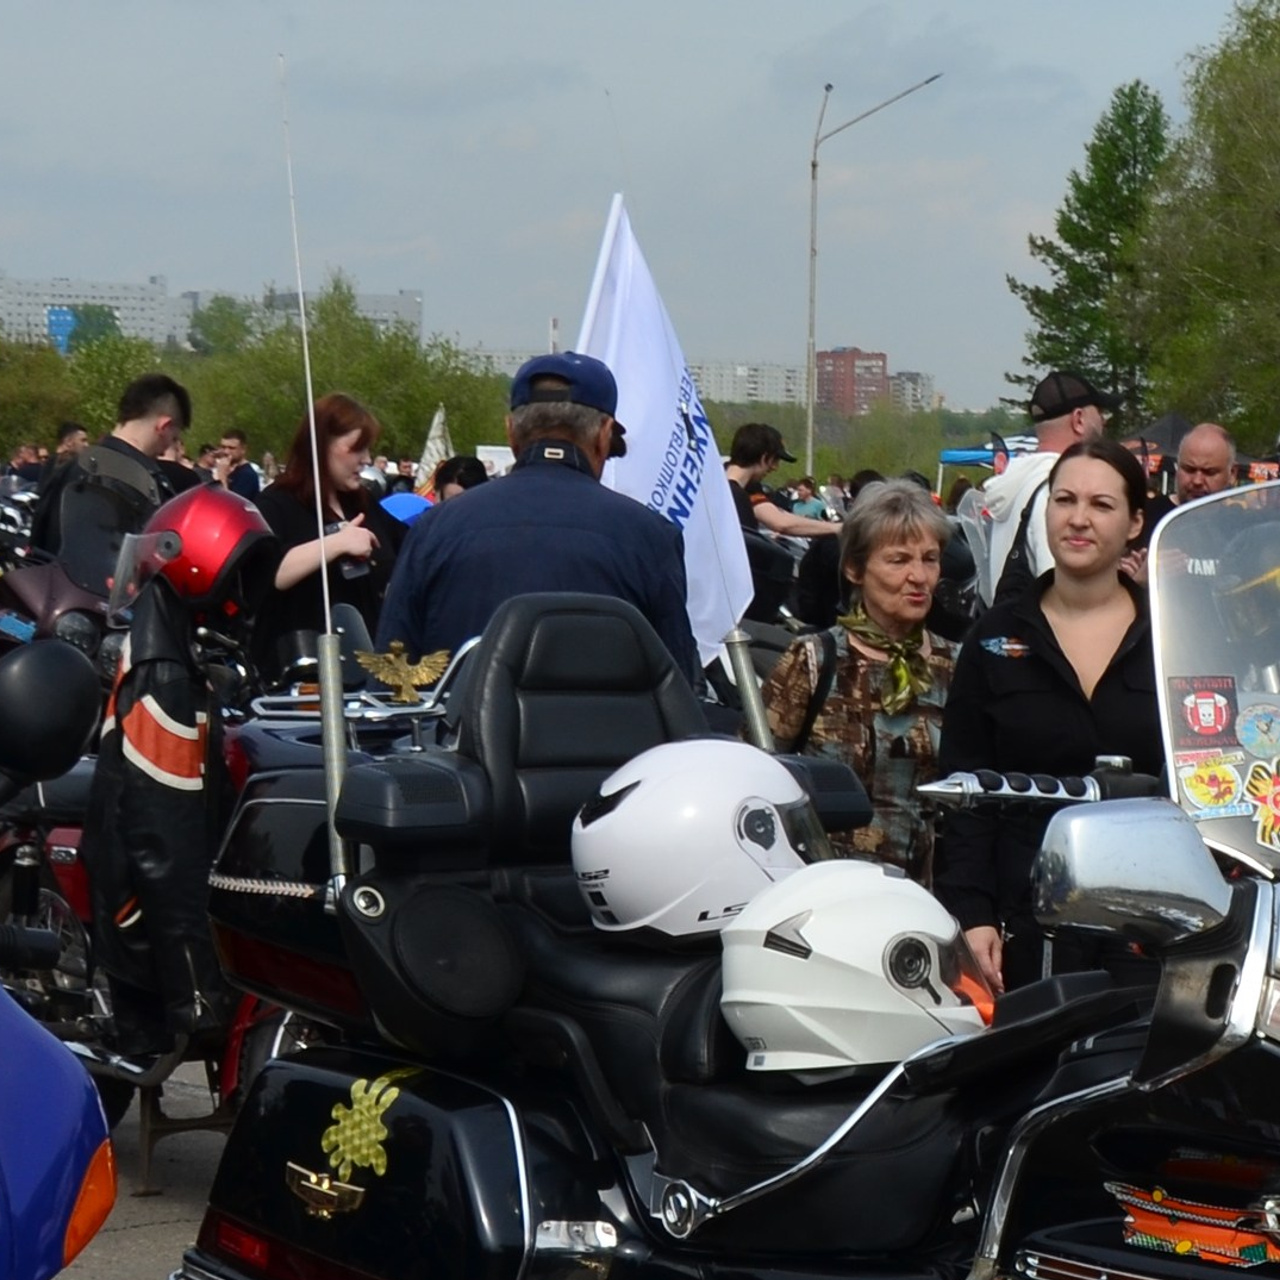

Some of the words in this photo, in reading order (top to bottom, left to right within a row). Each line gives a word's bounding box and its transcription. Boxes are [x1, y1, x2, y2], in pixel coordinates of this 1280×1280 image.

[1185, 558, 1219, 576] YAM
[576, 868, 610, 881] LS2
[697, 901, 749, 922] LS
